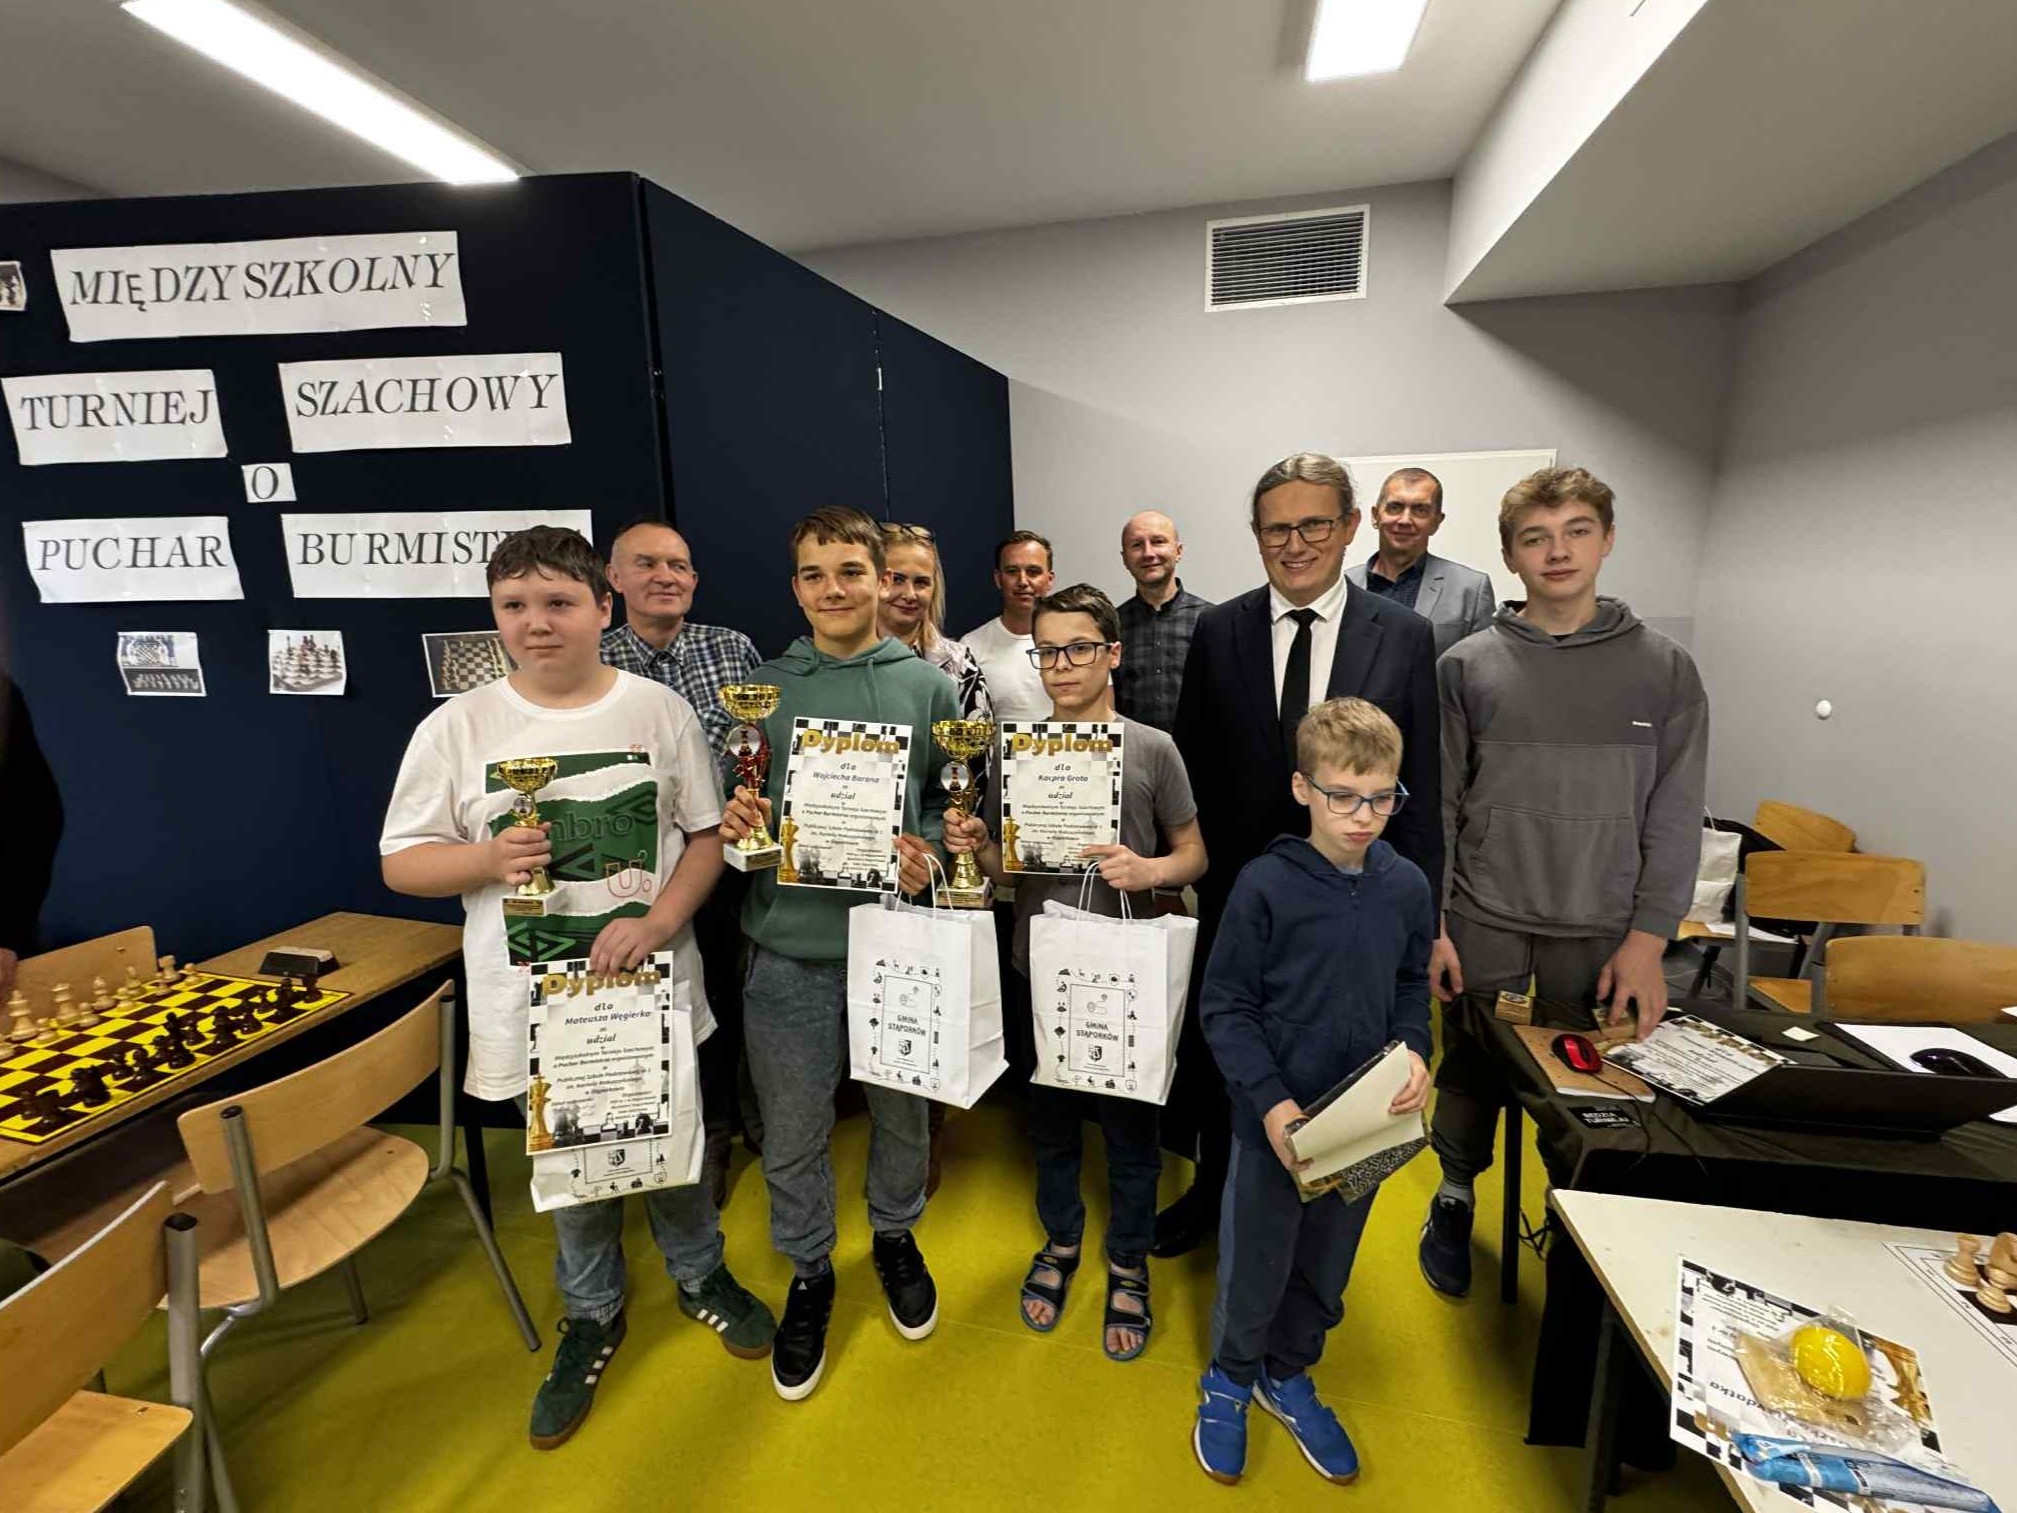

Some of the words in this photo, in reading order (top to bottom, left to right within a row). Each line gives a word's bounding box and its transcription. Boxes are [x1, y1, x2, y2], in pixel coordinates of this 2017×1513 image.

[21, 389, 214, 430] TURNIEJ
[296, 373, 558, 417] SZACHOWY
[251, 465, 279, 499] O
[36, 535, 227, 570] PUCHAR
[297, 529, 584, 565] BURMIST
[801, 729, 900, 755] Dyplom
[1012, 733, 1113, 756] Dyplom
[840, 762, 857, 771] dla
[1055, 763, 1071, 771] dla
[813, 772, 850, 782] Wojciecha
[1038, 774, 1066, 784] Kacpra
[543, 970, 661, 998] Dyplom
[594, 1003, 613, 1012] dla
[565, 1014, 608, 1026] Mateusza
[897, 1014, 918, 1025] GMINA
[1085, 1021, 1109, 1031] GMINA
